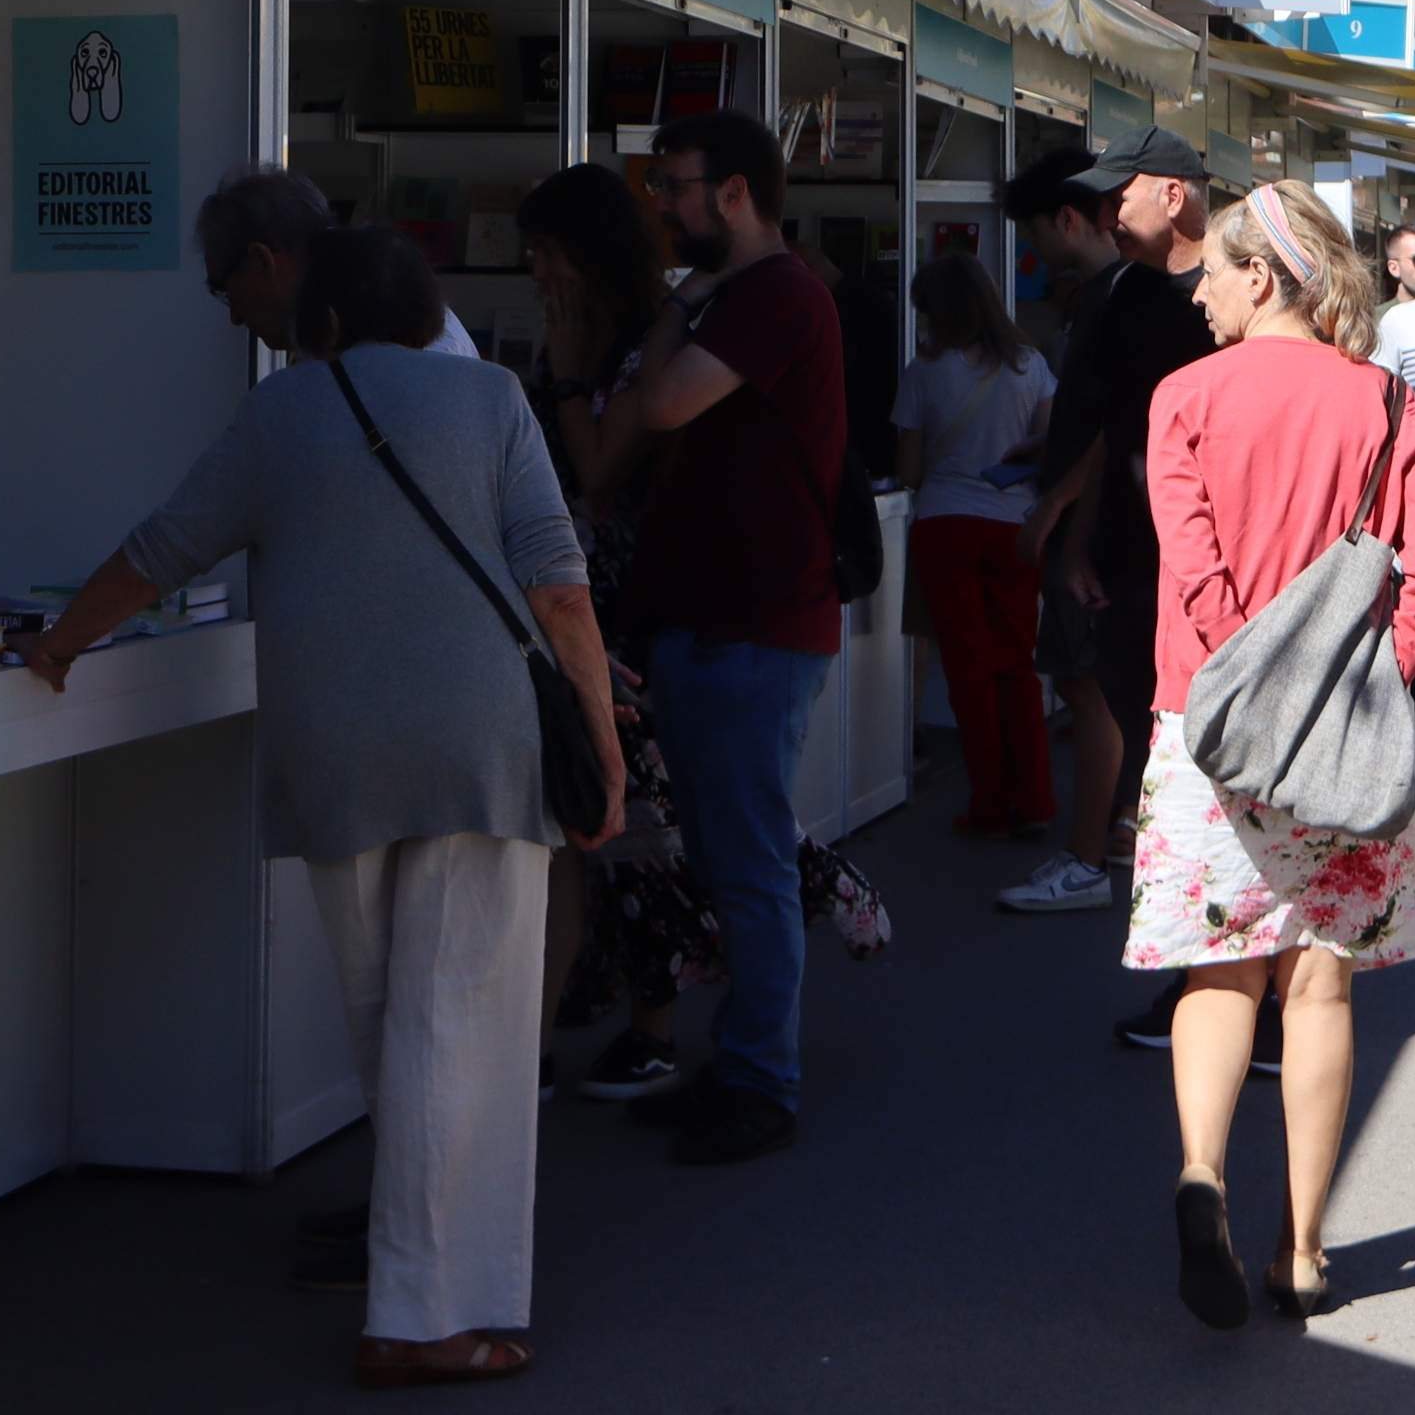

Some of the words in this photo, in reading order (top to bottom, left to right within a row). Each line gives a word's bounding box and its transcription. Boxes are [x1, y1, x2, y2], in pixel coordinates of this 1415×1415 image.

[409, 7, 432, 34] 55
[435, 10, 489, 37] URNES
[1349, 19, 1363, 39] 9
[412, 35, 444, 60] PER
[448, 37, 470, 62] LA
[415, 61, 496, 88] LLIBERTAT
[38, 171, 152, 196] EDITORIAL
[38, 201, 152, 226] FINESTRES
